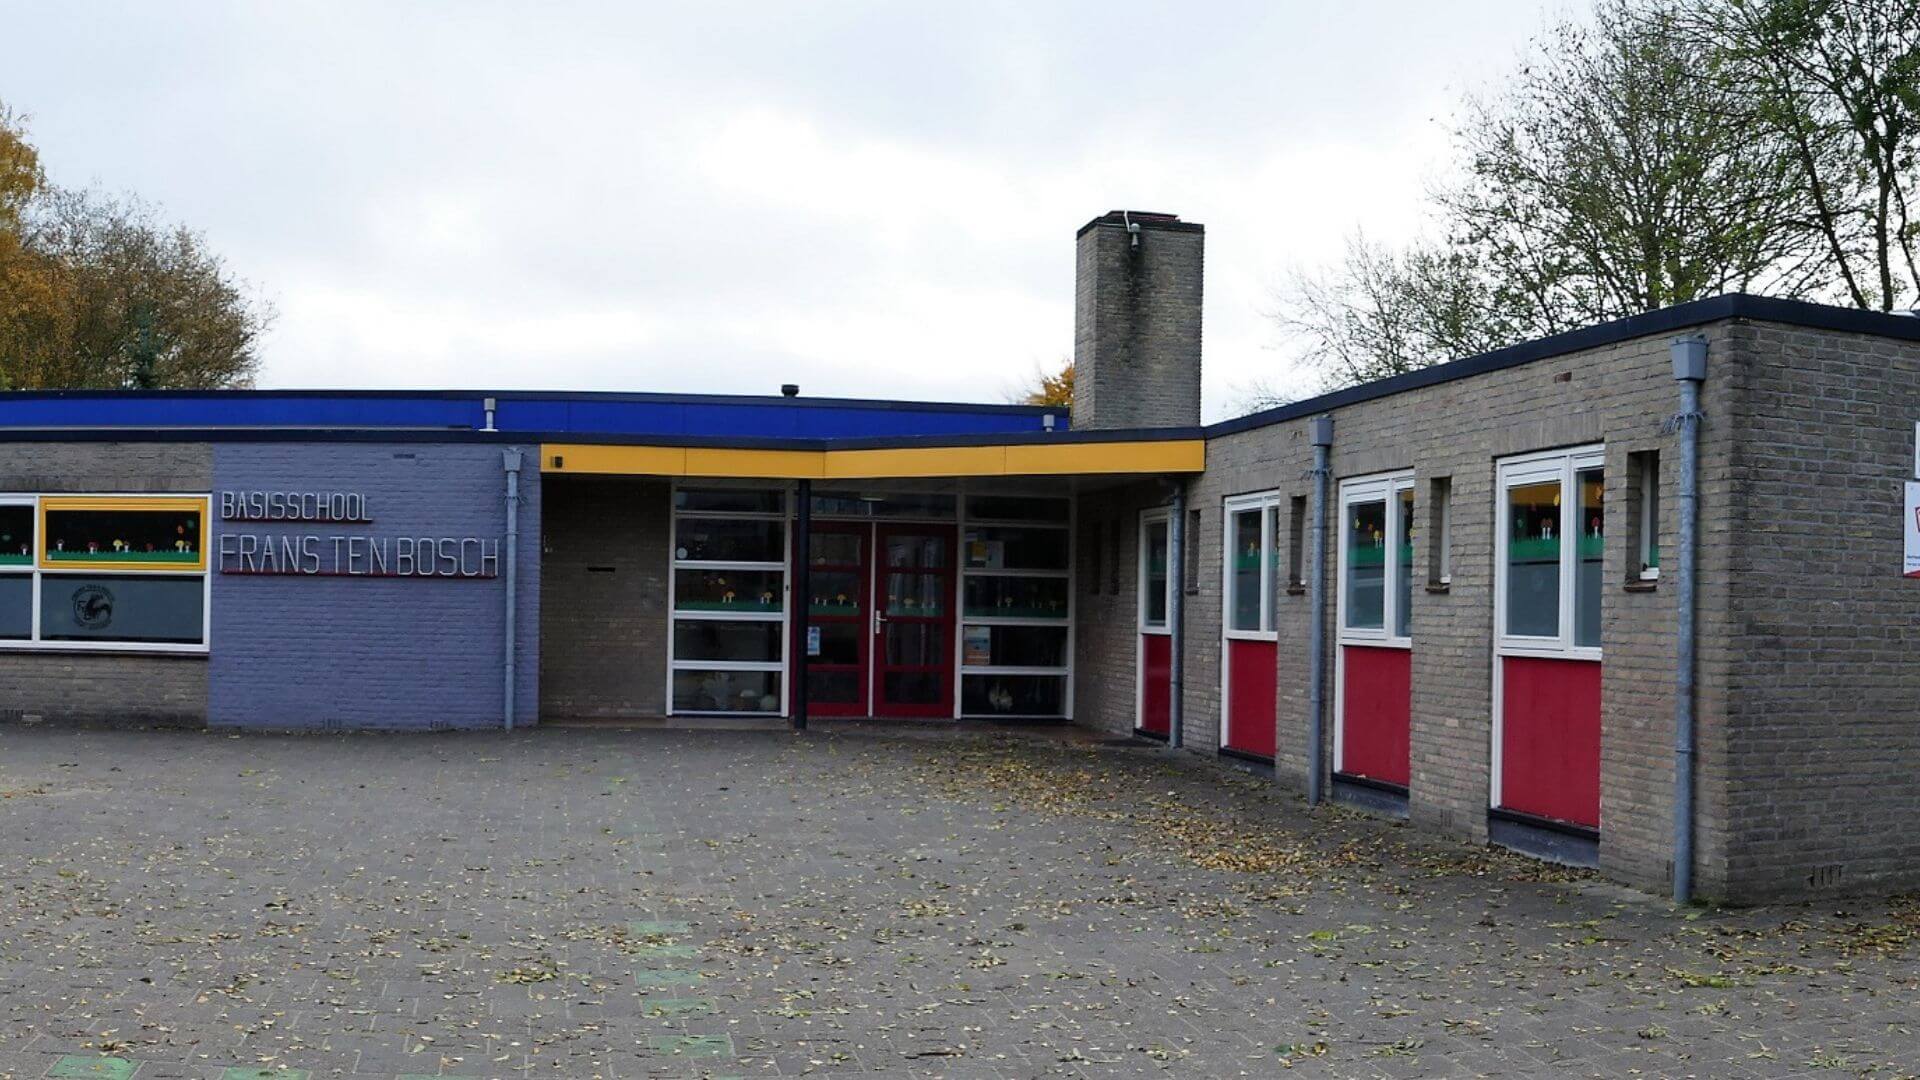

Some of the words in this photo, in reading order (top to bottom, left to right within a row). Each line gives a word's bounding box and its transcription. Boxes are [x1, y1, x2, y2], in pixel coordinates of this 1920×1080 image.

[221, 490, 373, 521] BASISSCHOOL
[219, 533, 320, 574] FRANS
[329, 535, 387, 575] TEN
[397, 537, 499, 577] BOSCH
